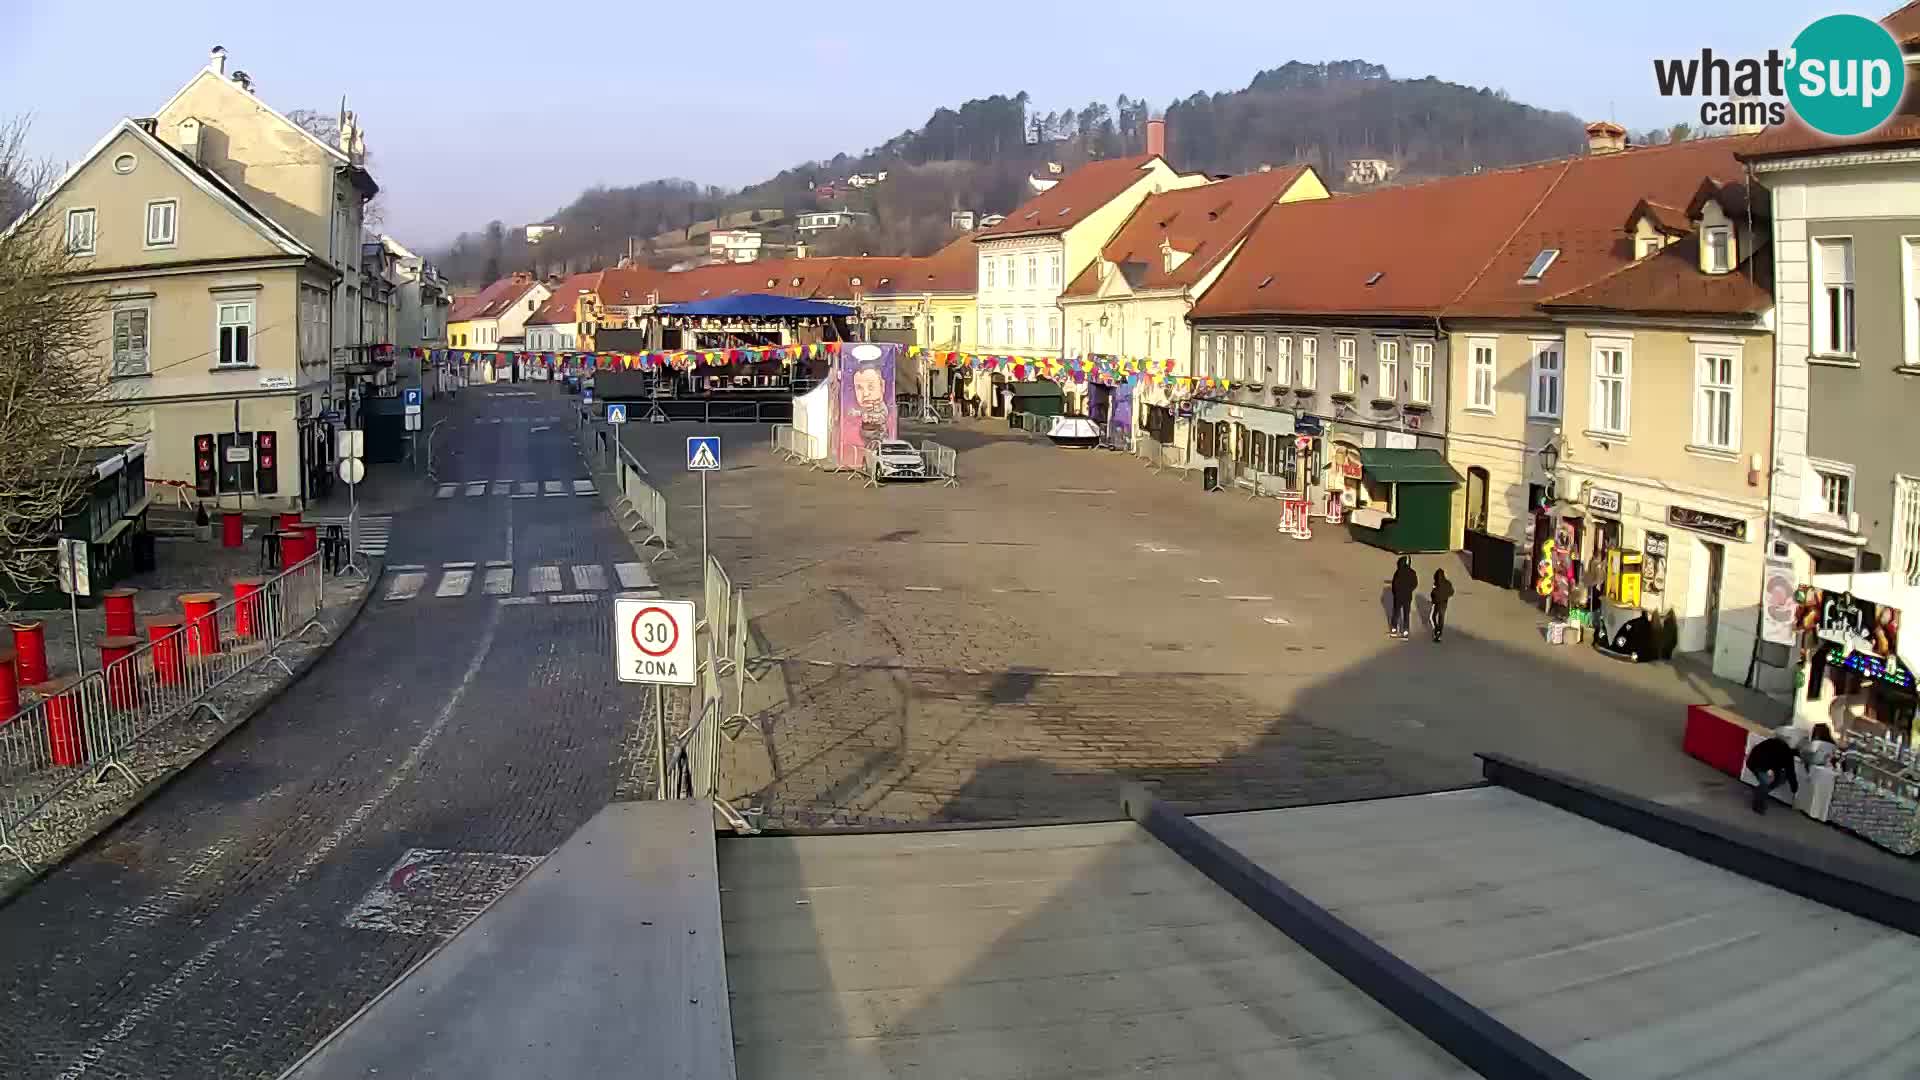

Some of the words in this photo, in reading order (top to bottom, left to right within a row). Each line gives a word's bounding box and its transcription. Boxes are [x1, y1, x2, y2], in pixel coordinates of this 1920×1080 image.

[408, 392, 417, 403] P
[644, 622, 668, 643] 30
[634, 659, 678, 676] ZONA
